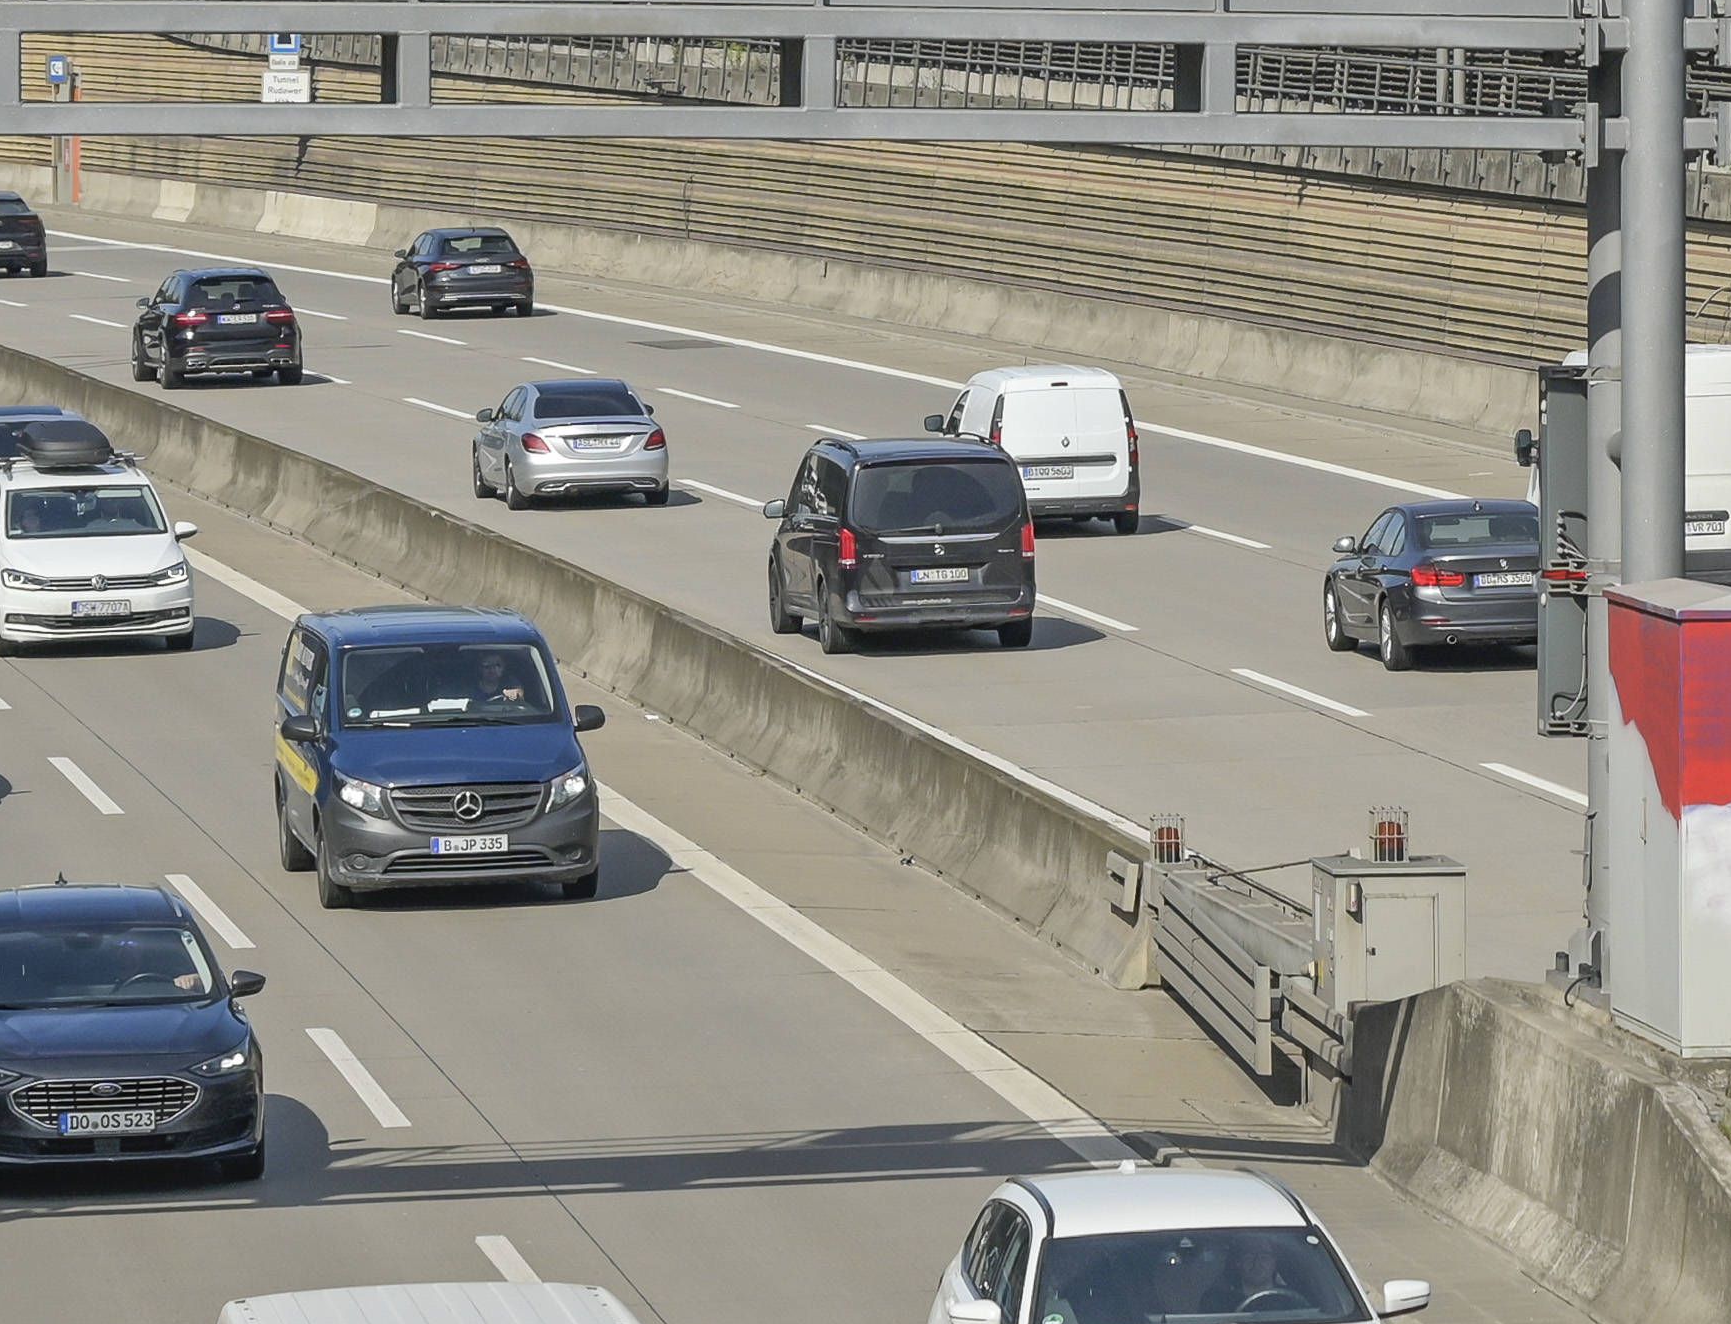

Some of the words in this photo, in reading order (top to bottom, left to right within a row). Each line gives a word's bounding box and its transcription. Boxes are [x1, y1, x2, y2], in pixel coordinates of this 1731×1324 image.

[273, 76, 299, 84] Tunnel
[444, 839, 452, 851] B
[461, 838, 477, 851] JP
[479, 836, 503, 850] 335
[70, 1115, 91, 1130] DO
[101, 1114, 121, 1129] OS
[123, 1112, 154, 1128] 523
